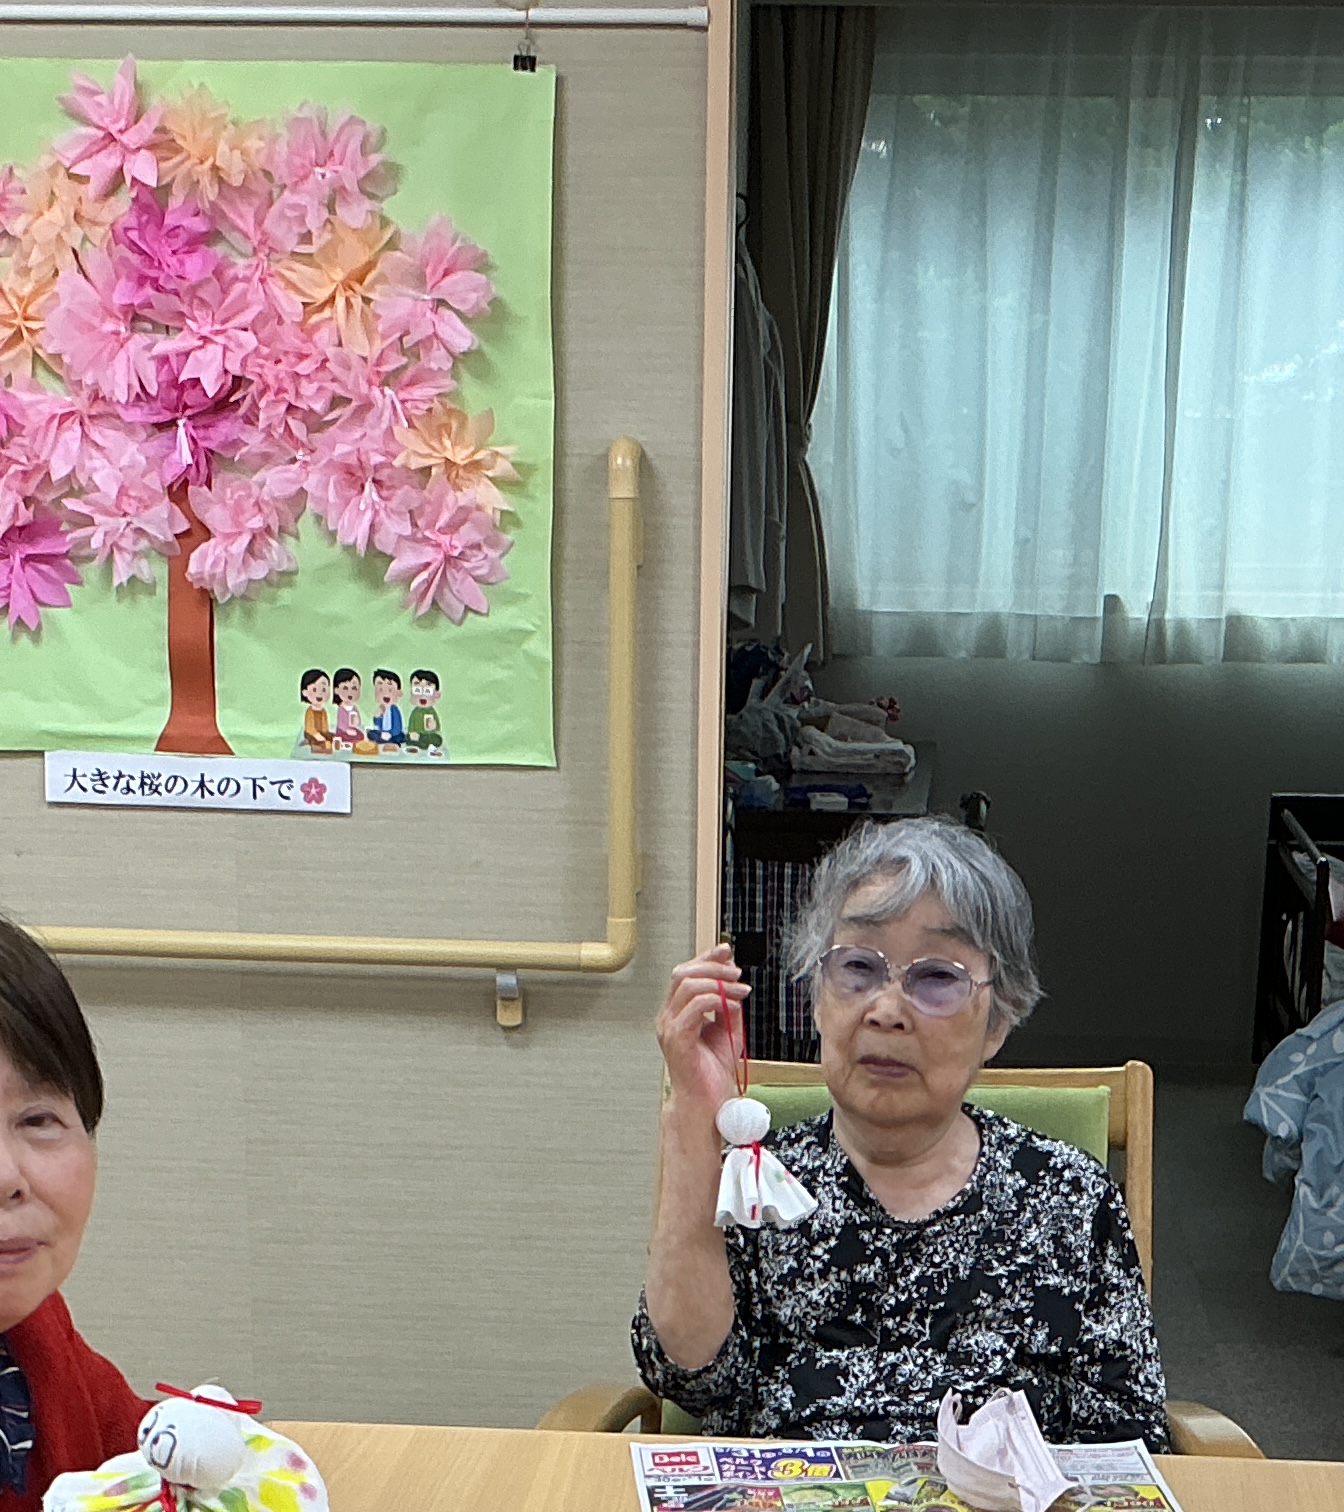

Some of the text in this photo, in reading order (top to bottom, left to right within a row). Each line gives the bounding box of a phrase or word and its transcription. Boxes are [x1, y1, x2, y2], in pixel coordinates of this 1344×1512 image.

[64, 767, 295, 801] 大きな桜の木の下で
